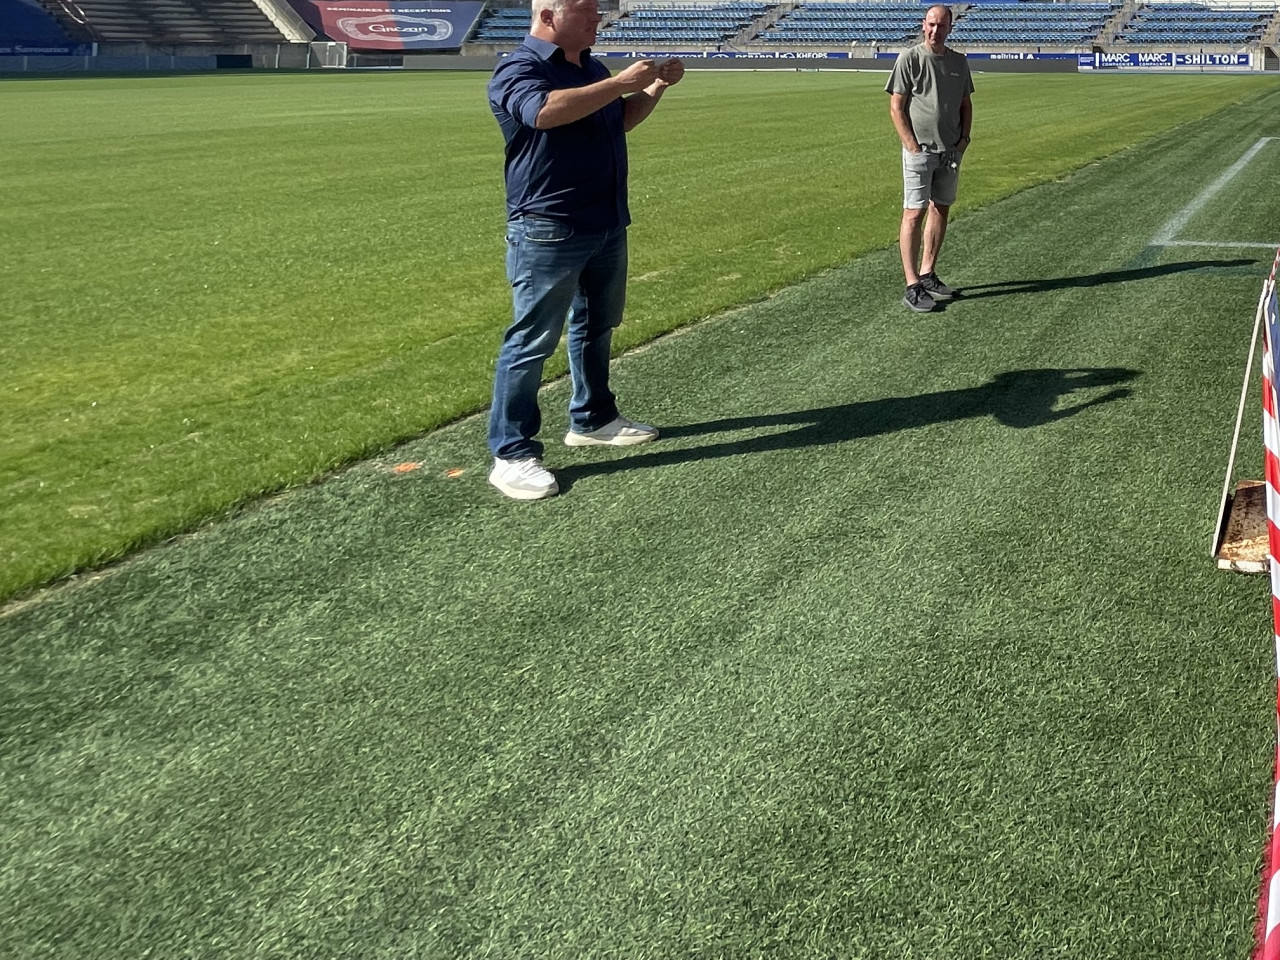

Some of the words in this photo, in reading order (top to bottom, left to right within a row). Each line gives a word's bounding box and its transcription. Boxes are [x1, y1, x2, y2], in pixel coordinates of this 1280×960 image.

[1102, 53, 1131, 63] MARC
[1139, 53, 1168, 63] MARC
[1185, 54, 1238, 65] SHILTON
